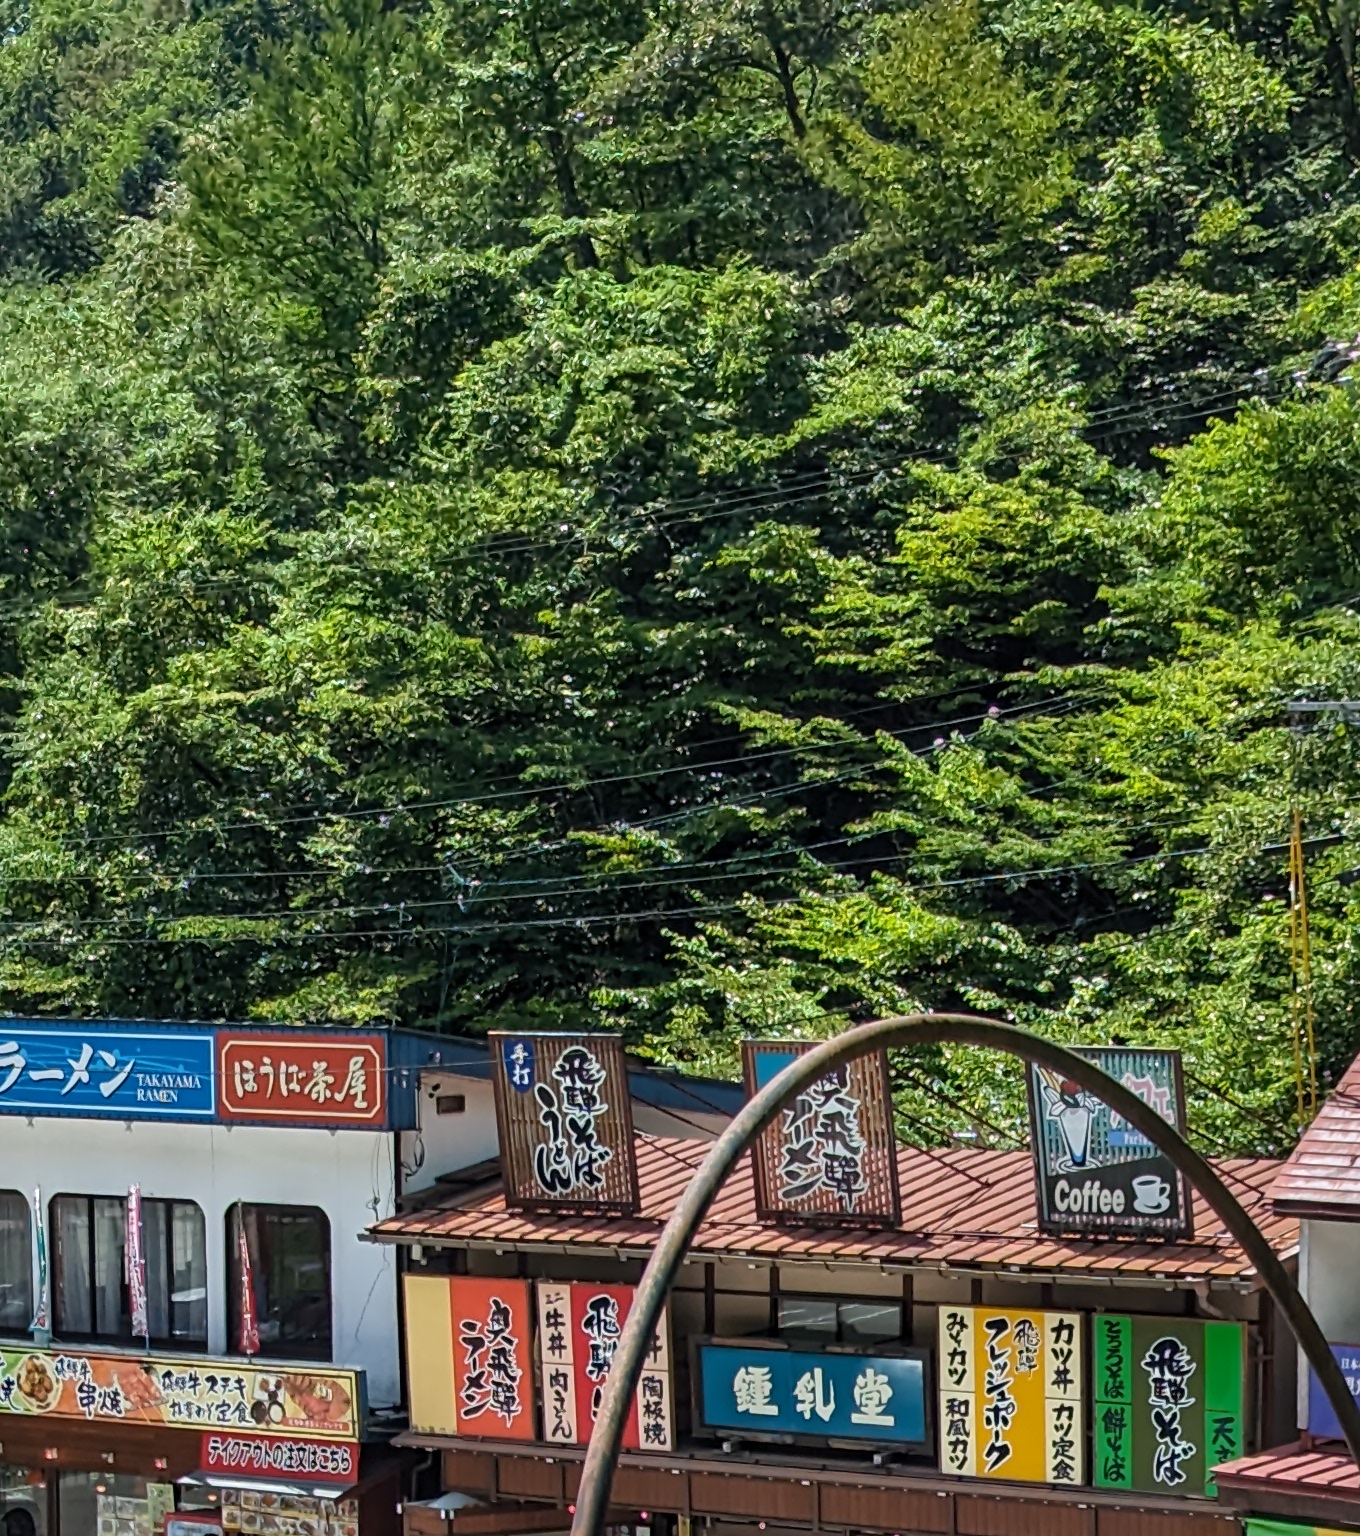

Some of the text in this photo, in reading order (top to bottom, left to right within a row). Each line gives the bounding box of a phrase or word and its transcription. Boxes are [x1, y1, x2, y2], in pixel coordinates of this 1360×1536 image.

[136, 1073, 202, 1089] TAKAYAMA
[136, 1087, 179, 1103] RAMEN
[233, 1055, 369, 1109] ほうば茶屋
[510, 1044, 530, 1086] 手打
[534, 1082, 571, 1195] うどん
[1053, 1178, 1126, 1214] Coffee
[459, 1319, 491, 1420] ラーメン
[945, 1311, 969, 1387] みそカツ
[1049, 1316, 1076, 1396] カツ丼
[1103, 1319, 1127, 1399] とろろそば
[76, 1380, 126, 1420] 串焼
[548, 1367, 573, 1439] 肉うどん
[642, 1374, 667, 1446] 陶板焼
[982, 1315, 1017, 1475] フレッシュポーク
[207, 1436, 353, 1475] テイクアウトの注文はこちら
[945, 1397, 971, 1472] 和風カツ
[1051, 1402, 1076, 1483] カツ定食
